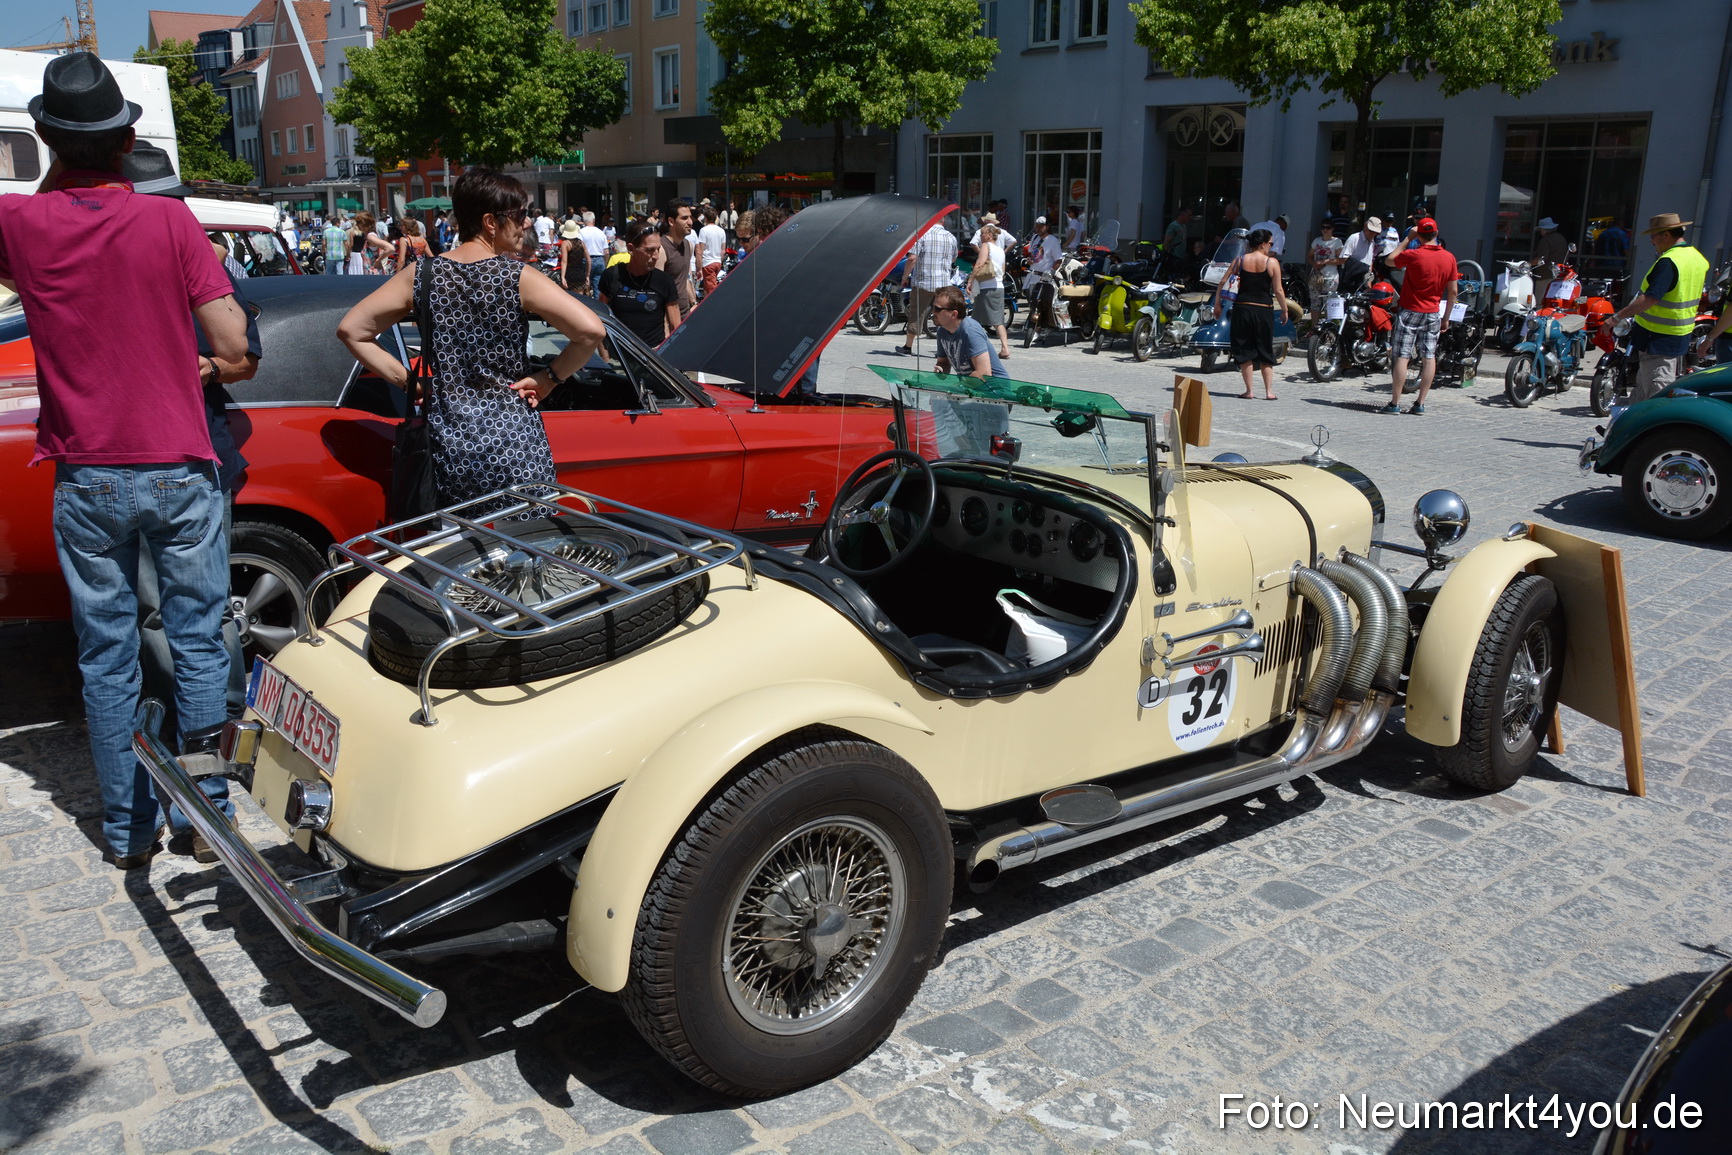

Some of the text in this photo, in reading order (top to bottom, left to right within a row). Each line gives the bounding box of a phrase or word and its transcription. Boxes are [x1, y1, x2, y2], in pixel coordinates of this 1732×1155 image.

[766, 508, 803, 522] Mustang
[1148, 680, 1160, 703] D
[1182, 669, 1228, 726] 32
[257, 669, 337, 764] NM 06353
